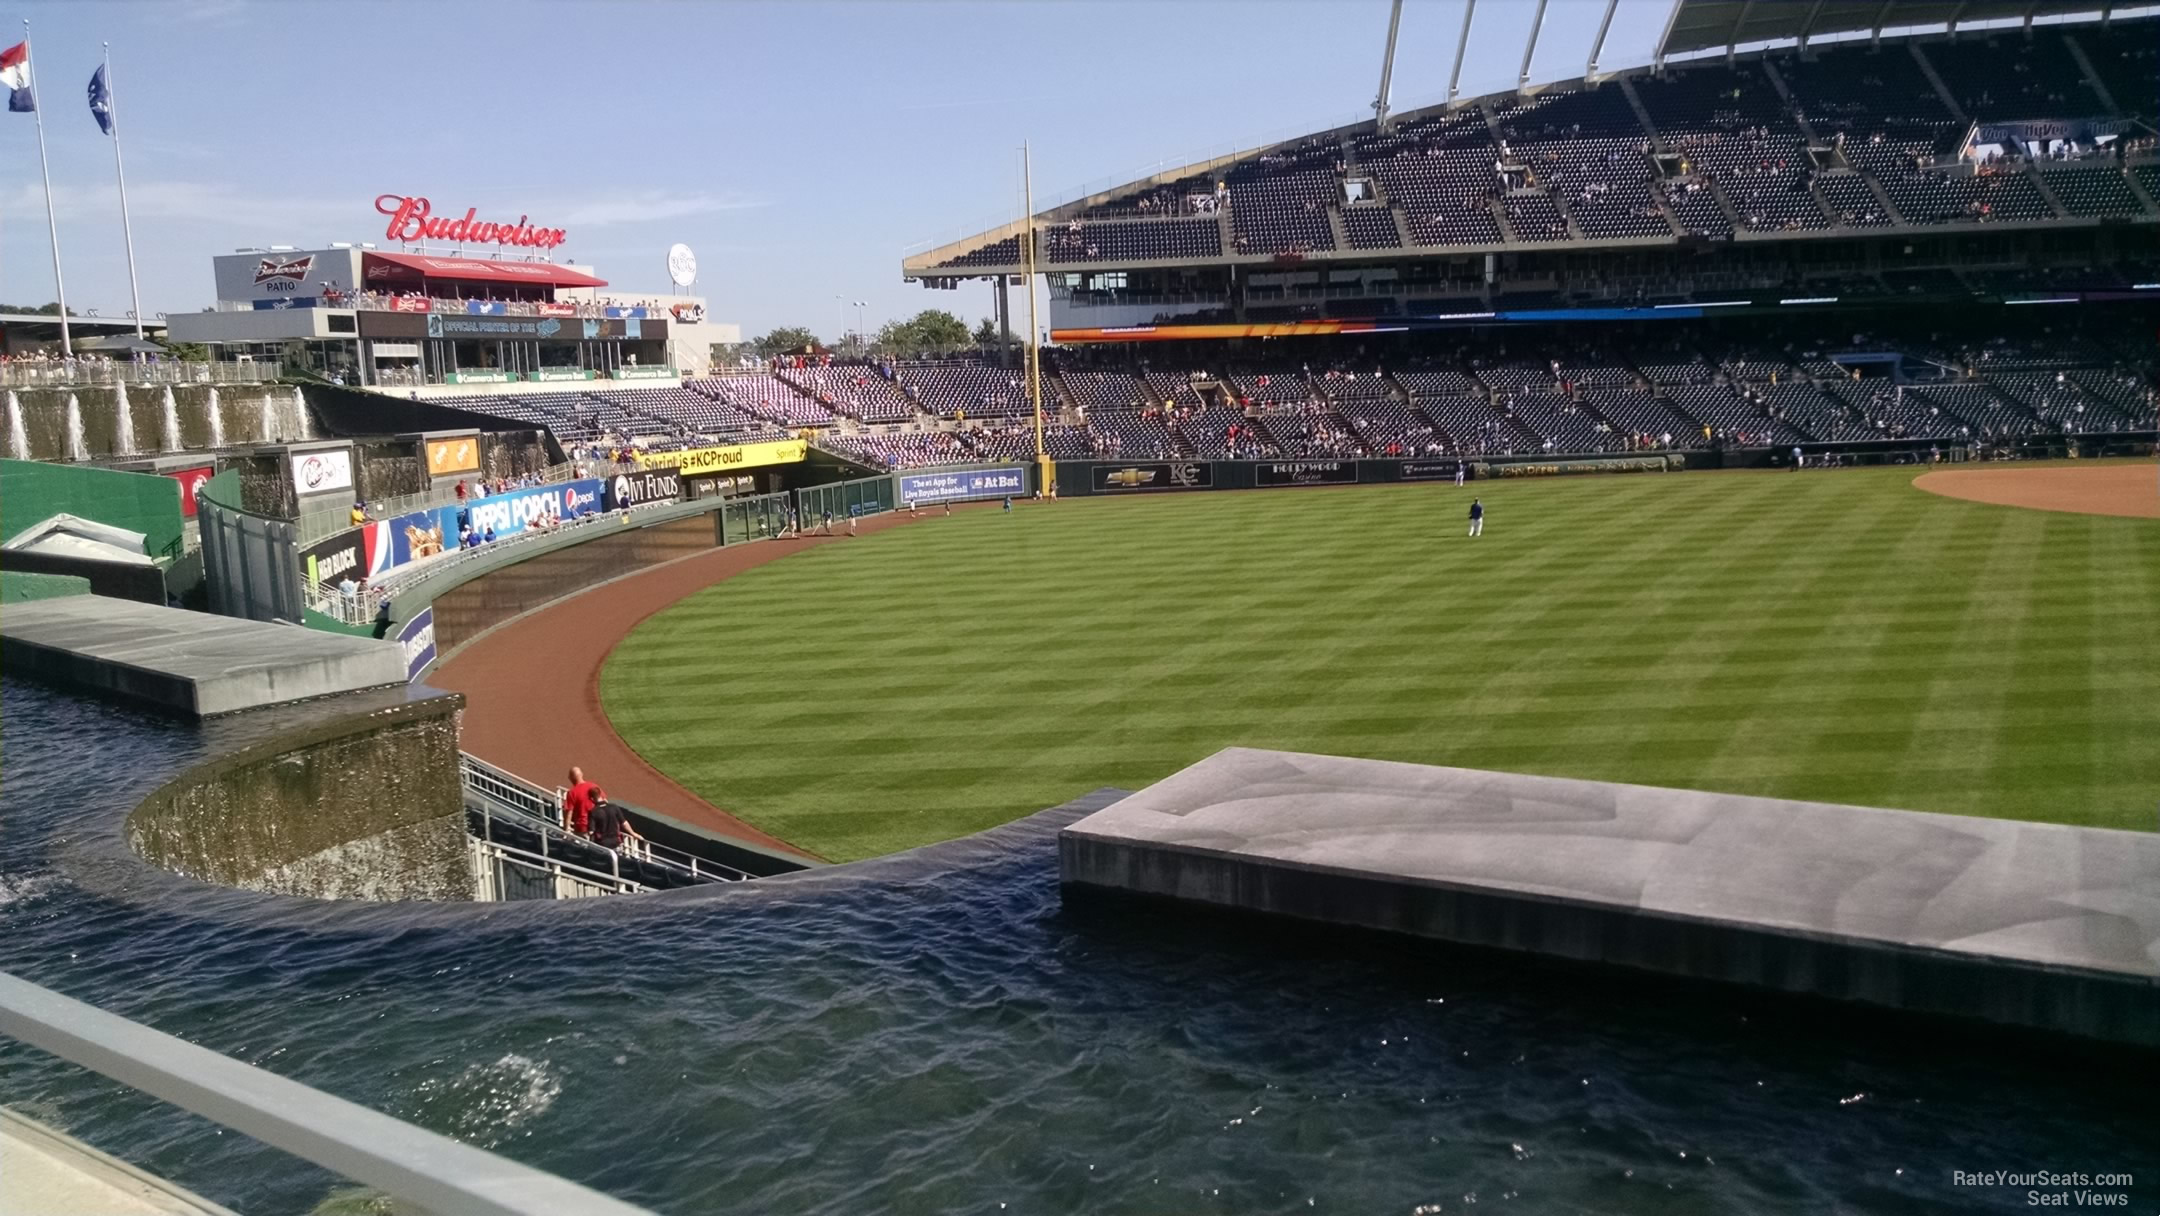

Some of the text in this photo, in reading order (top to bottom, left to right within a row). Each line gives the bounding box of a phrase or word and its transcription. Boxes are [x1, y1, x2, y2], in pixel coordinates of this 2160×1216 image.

[375, 194, 566, 249] Budweiser
[256, 262, 313, 276] Budweiser
[267, 281, 295, 291] PATIO
[680, 309, 702, 320] RIVALS
[444, 320, 478, 332] OFFICIAL
[510, 323, 520, 333] OF
[521, 322, 536, 333] THE
[463, 373, 508, 383] Commerce Bank
[544, 372, 587, 381] Commerce Bank
[657, 370, 672, 378] Bank
[680, 454, 689, 469] is
[690, 448, 743, 467] #KCProud
[776, 448, 796, 460] Sprint
[1272, 463, 1340, 473] HOLLYWOOD
[1500, 466, 1525, 476] JOHN
[1527, 465, 1560, 474] DEERE
[984, 476, 1018, 488] At Bat
[1291, 471, 1322, 481] Casino
[629, 473, 679, 502] IVY FUNDS
[912, 480, 925, 488] The
[933, 478, 947, 488] App
[948, 477, 957, 485] for
[905, 486, 968, 498] Live Royals Baseball
[577, 491, 594, 506] pepsi
[471, 491, 562, 534] PEPSI PORCH
[331, 547, 357, 575] BLOCK
